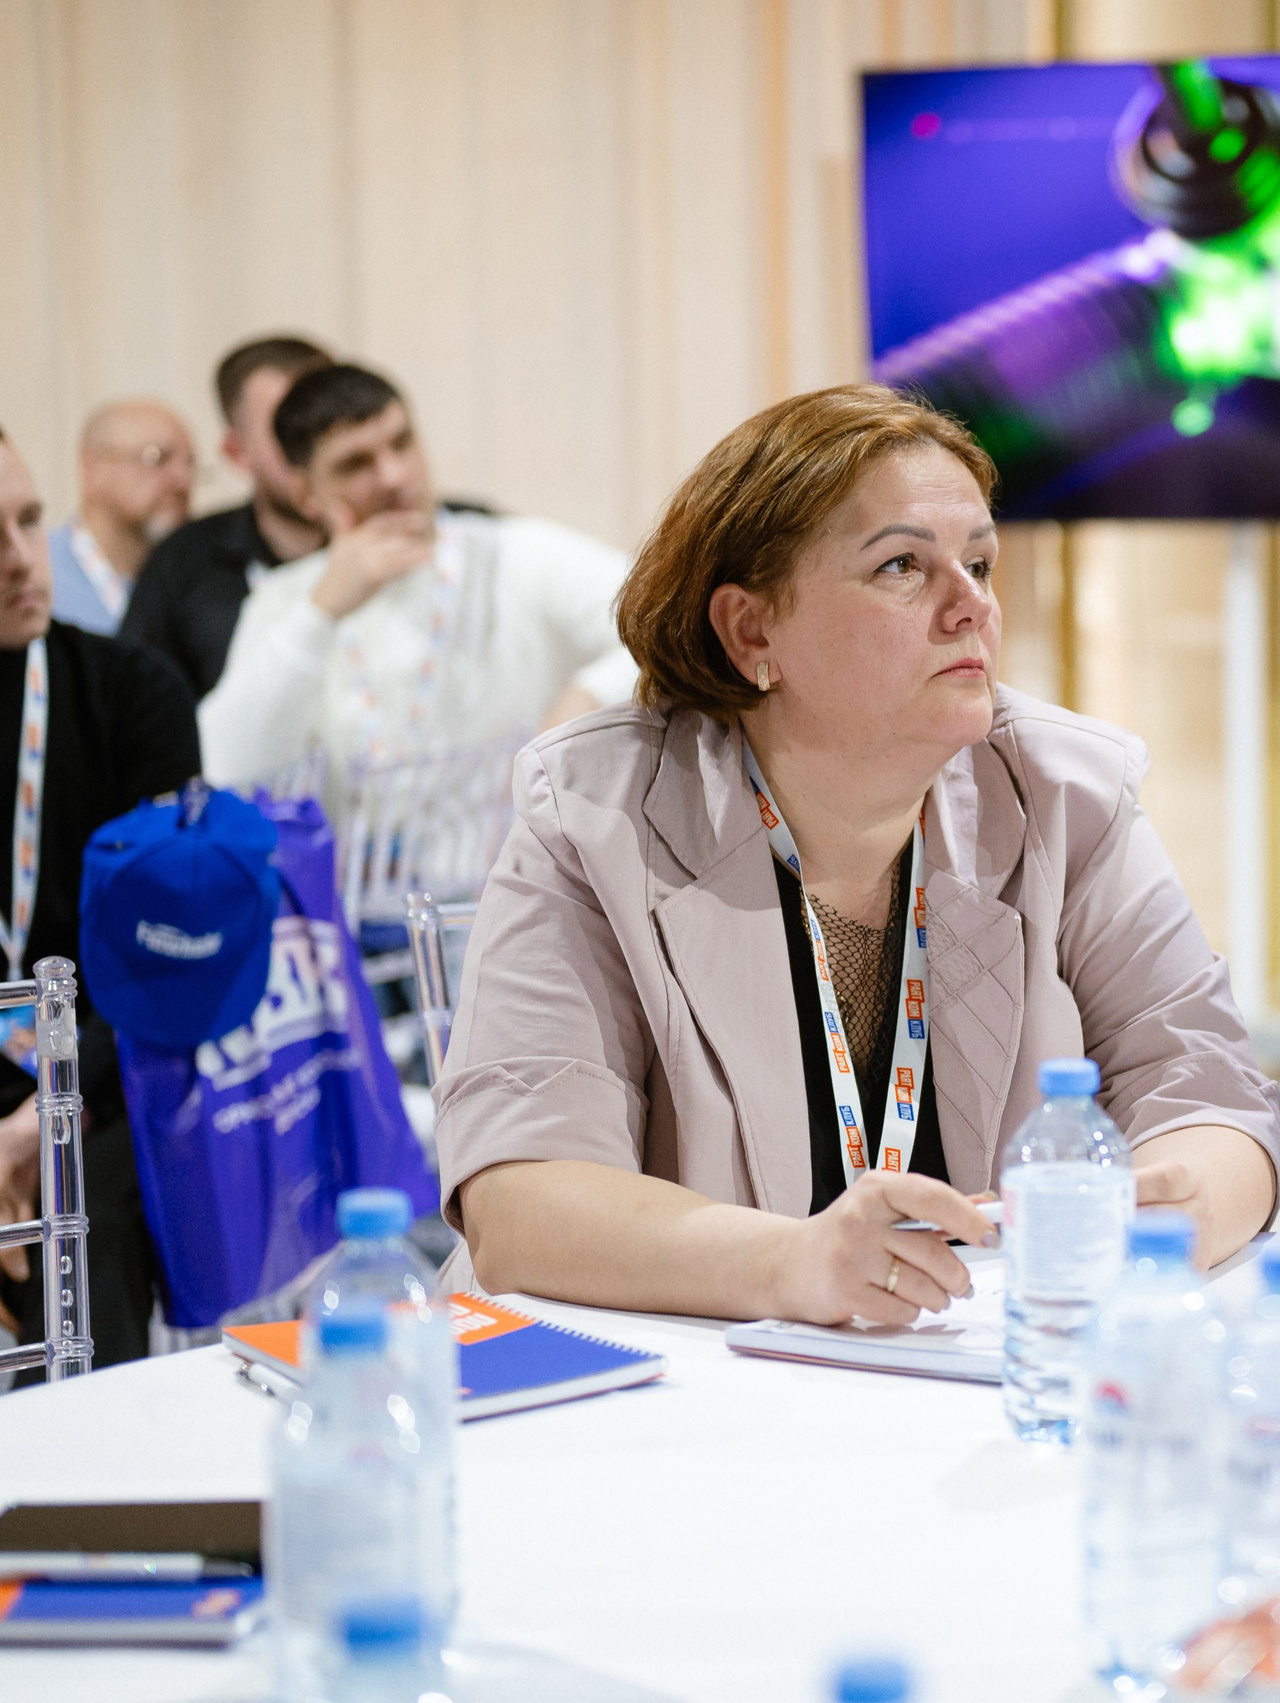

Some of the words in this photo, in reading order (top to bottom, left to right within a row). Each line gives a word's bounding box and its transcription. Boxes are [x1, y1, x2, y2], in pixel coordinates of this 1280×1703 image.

[909, 981, 923, 1000] PART
[899, 1069, 912, 1087] PART
[850, 1147, 863, 1166] PART
[887, 1150, 899, 1171] PART
